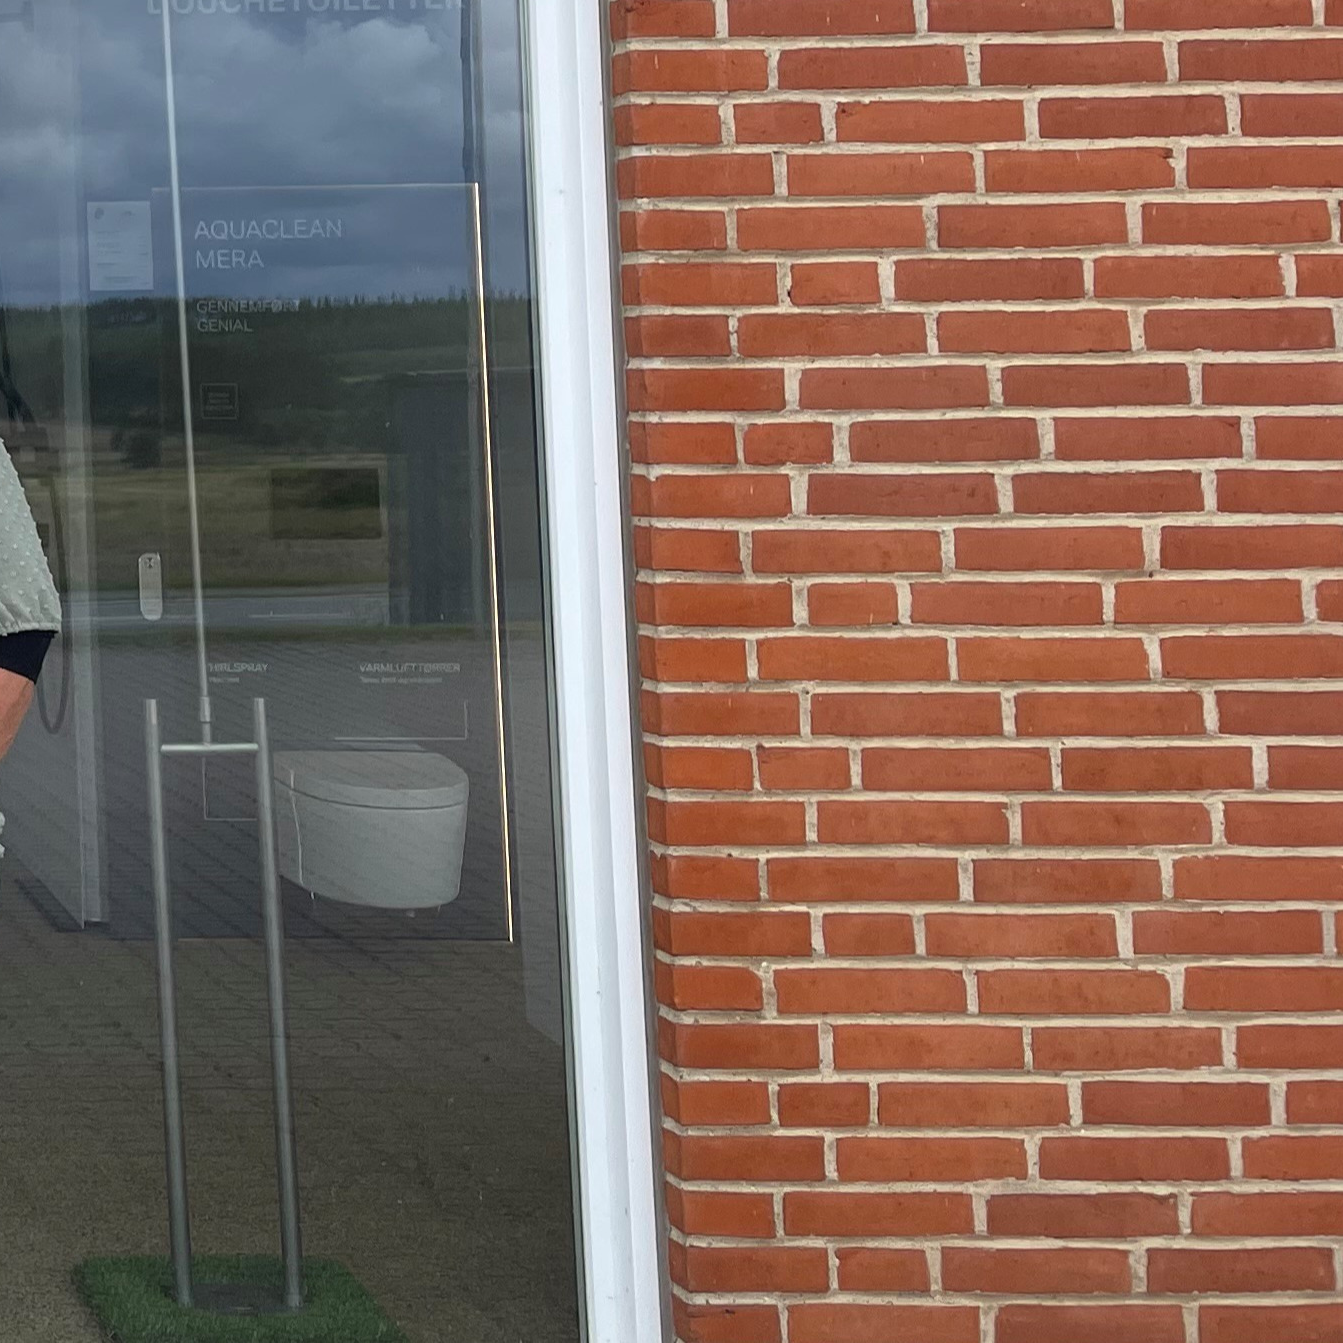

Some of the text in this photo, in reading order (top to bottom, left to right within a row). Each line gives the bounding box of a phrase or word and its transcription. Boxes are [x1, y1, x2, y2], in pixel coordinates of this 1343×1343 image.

[194, 218, 342, 240] AQUACLEAN
[196, 249, 265, 269] MERA
[197, 318, 254, 333] GENIAL
